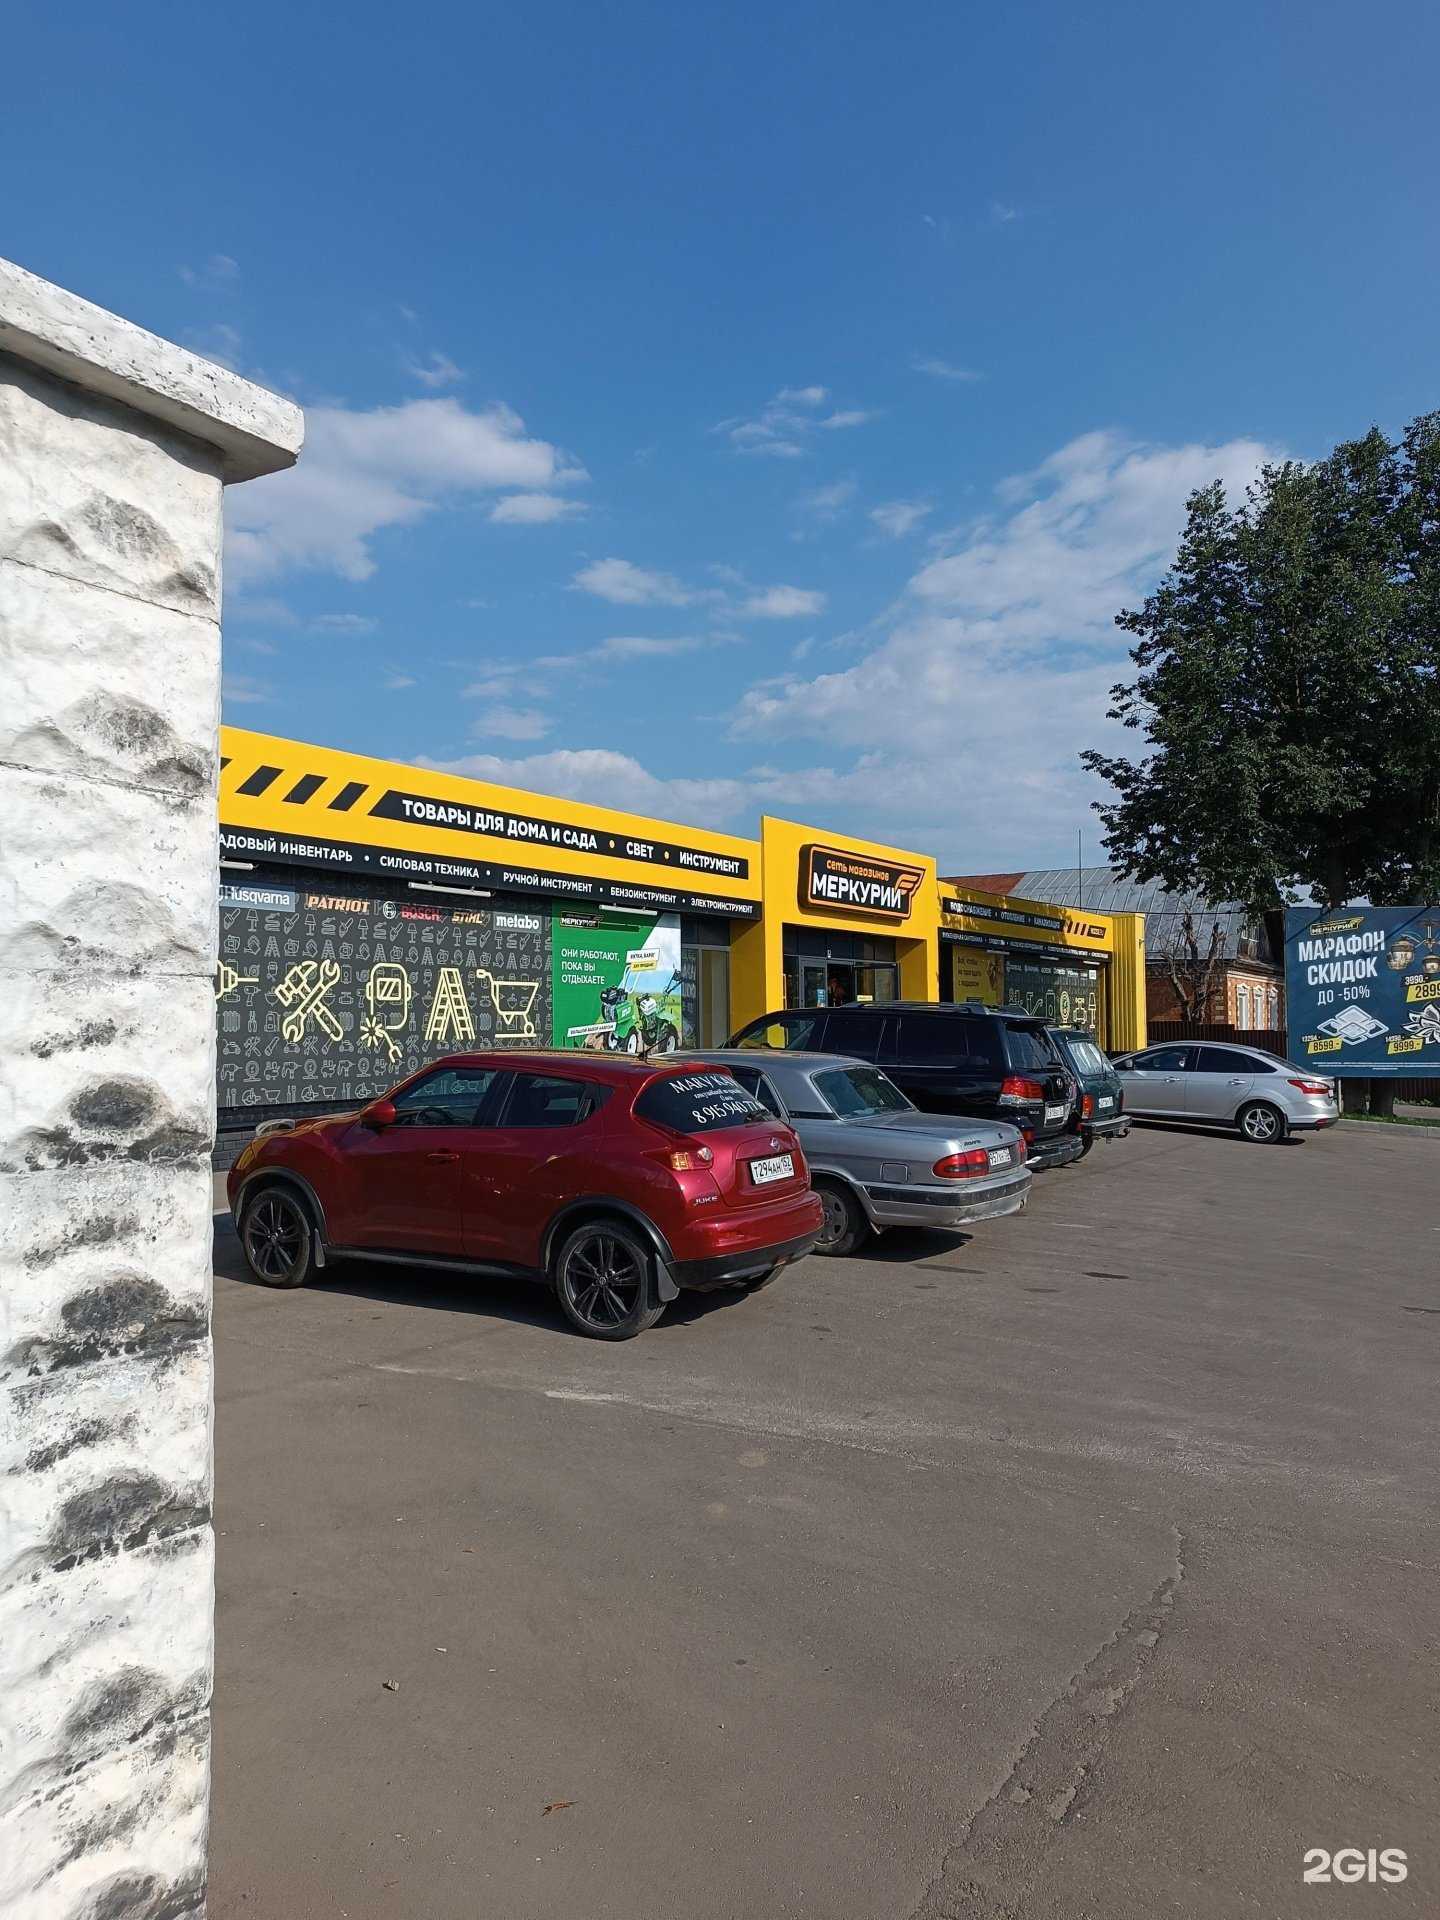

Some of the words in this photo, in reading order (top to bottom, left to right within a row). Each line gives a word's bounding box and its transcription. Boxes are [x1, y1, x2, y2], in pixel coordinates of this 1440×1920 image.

[402, 799, 470, 826] ТОВАРЫ
[474, 811, 504, 834] ДЛЯ
[507, 818, 548, 840] ДОМА
[551, 828, 561, 842] И
[563, 829, 597, 850] САДА
[219, 832, 277, 854] АДОВЫЙ
[279, 843, 353, 862] ИНВЕНТАРЬ
[626, 841, 654, 859] СВЕТ
[379, 855, 432, 872] СИЛОВАЯ
[434, 862, 480, 879] ТЕХНИКА
[679, 851, 740, 874] ИНСТРУМЕНТ
[826, 859, 848, 872] сеть
[848, 864, 890, 882] магазинов
[503, 870, 539, 887] РУЧНОЙ
[540, 876, 593, 893] ИНСТРУМЕНТ
[812, 871, 902, 909] МЕРКУРИЙ
[230, 885, 290, 905] Husqvarna
[308, 894, 370, 913] PATRIOT
[610, 886, 677, 904] БЕНЗОИНСТРУМЕНТ
[400, 905, 441, 922] BOSCH
[690, 897, 753, 914] ЭЛЕКТРОИНСТРУМЕНТ
[496, 914, 540, 931] metabo
[561, 948, 578, 958] ОНИ
[579, 950, 620, 962] РАБОТАЮТ,
[1298, 930, 1385, 962] МАРАФОН
[561, 962, 583, 971] ПОКА
[584, 962, 596, 971] ВЫ
[1307, 956, 1378, 986] СКИДОК
[561, 975, 605, 985] ОТДЫХАЕТЕ
[1317, 990, 1334, 1006] ДО
[1338, 985, 1371, 1002] -50%
[669, 1076, 713, 1093] MARY
[692, 1110, 707, 1124] 8
[702, 1104, 727, 1120] 915
[724, 1101, 748, 1115] 940
[694, 1195, 718, 1207] JUKE
